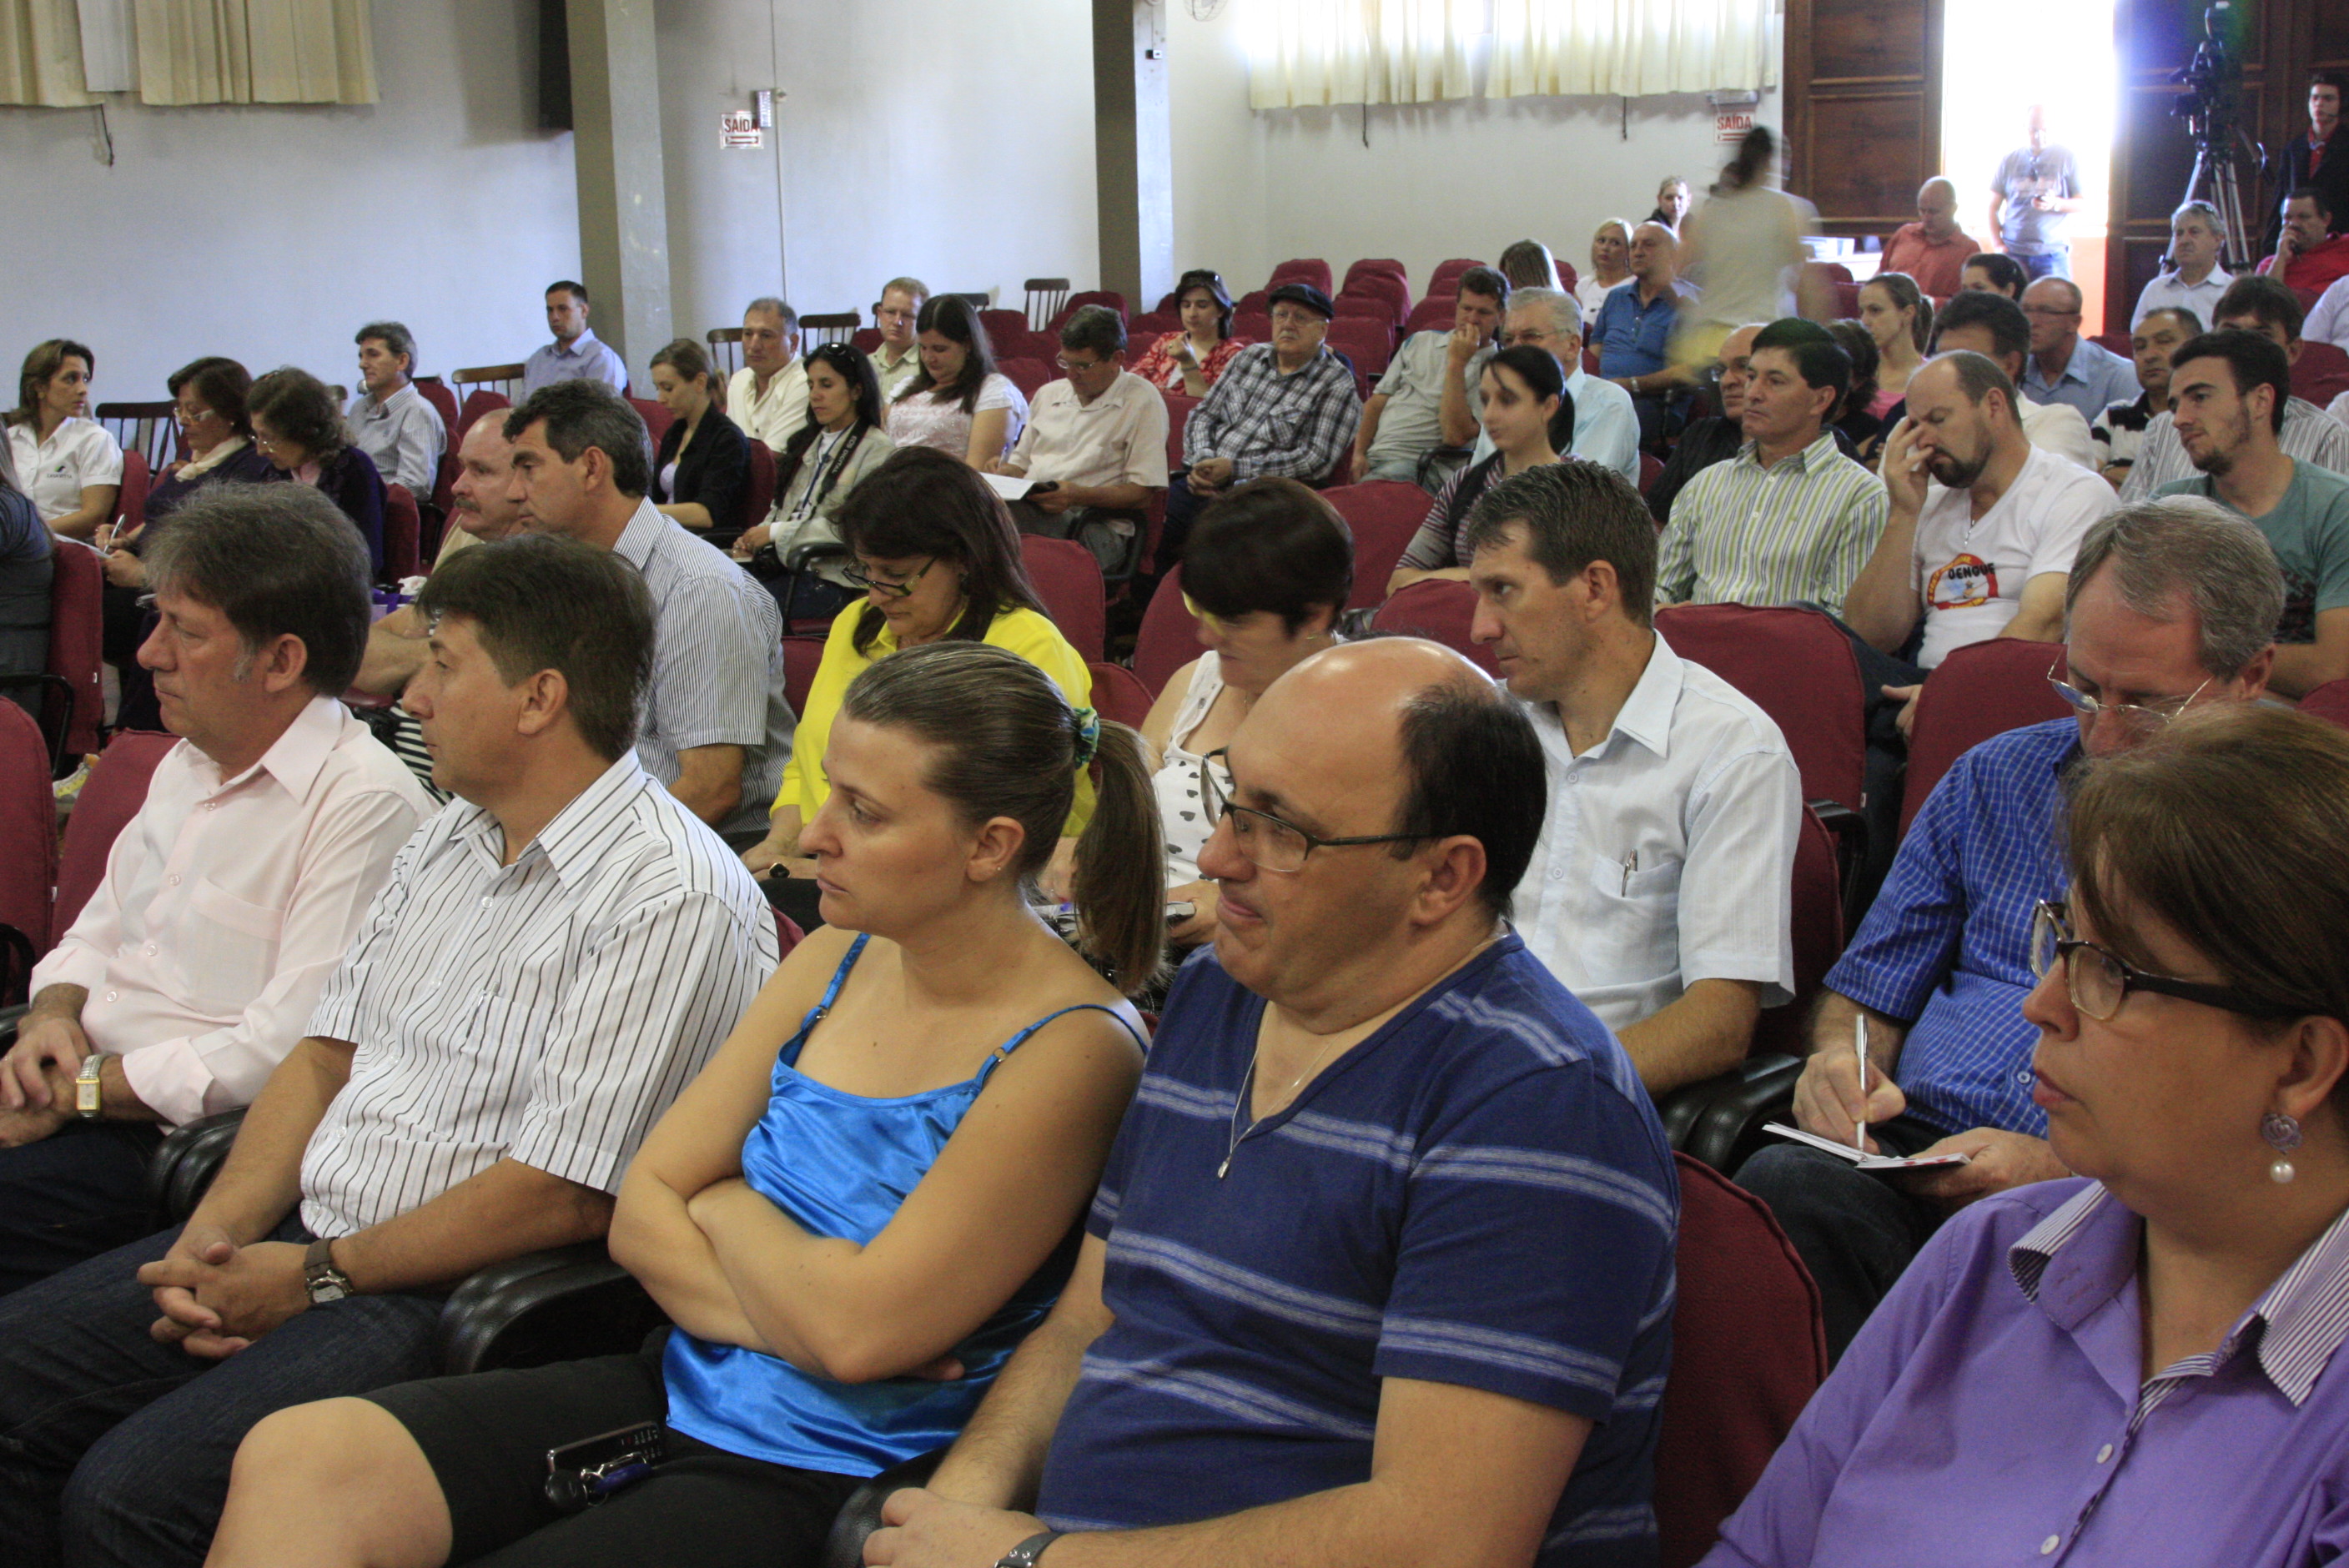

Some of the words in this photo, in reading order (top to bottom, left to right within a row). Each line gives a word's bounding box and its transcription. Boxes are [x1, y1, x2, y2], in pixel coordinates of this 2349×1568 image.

[724, 117, 761, 133] SAÍDA
[1718, 113, 1753, 130] SAÍDA
[848, 435, 858, 449] EOS
[832, 450, 849, 474] DIGITAL
[1948, 562, 1996, 580] DENGUE
